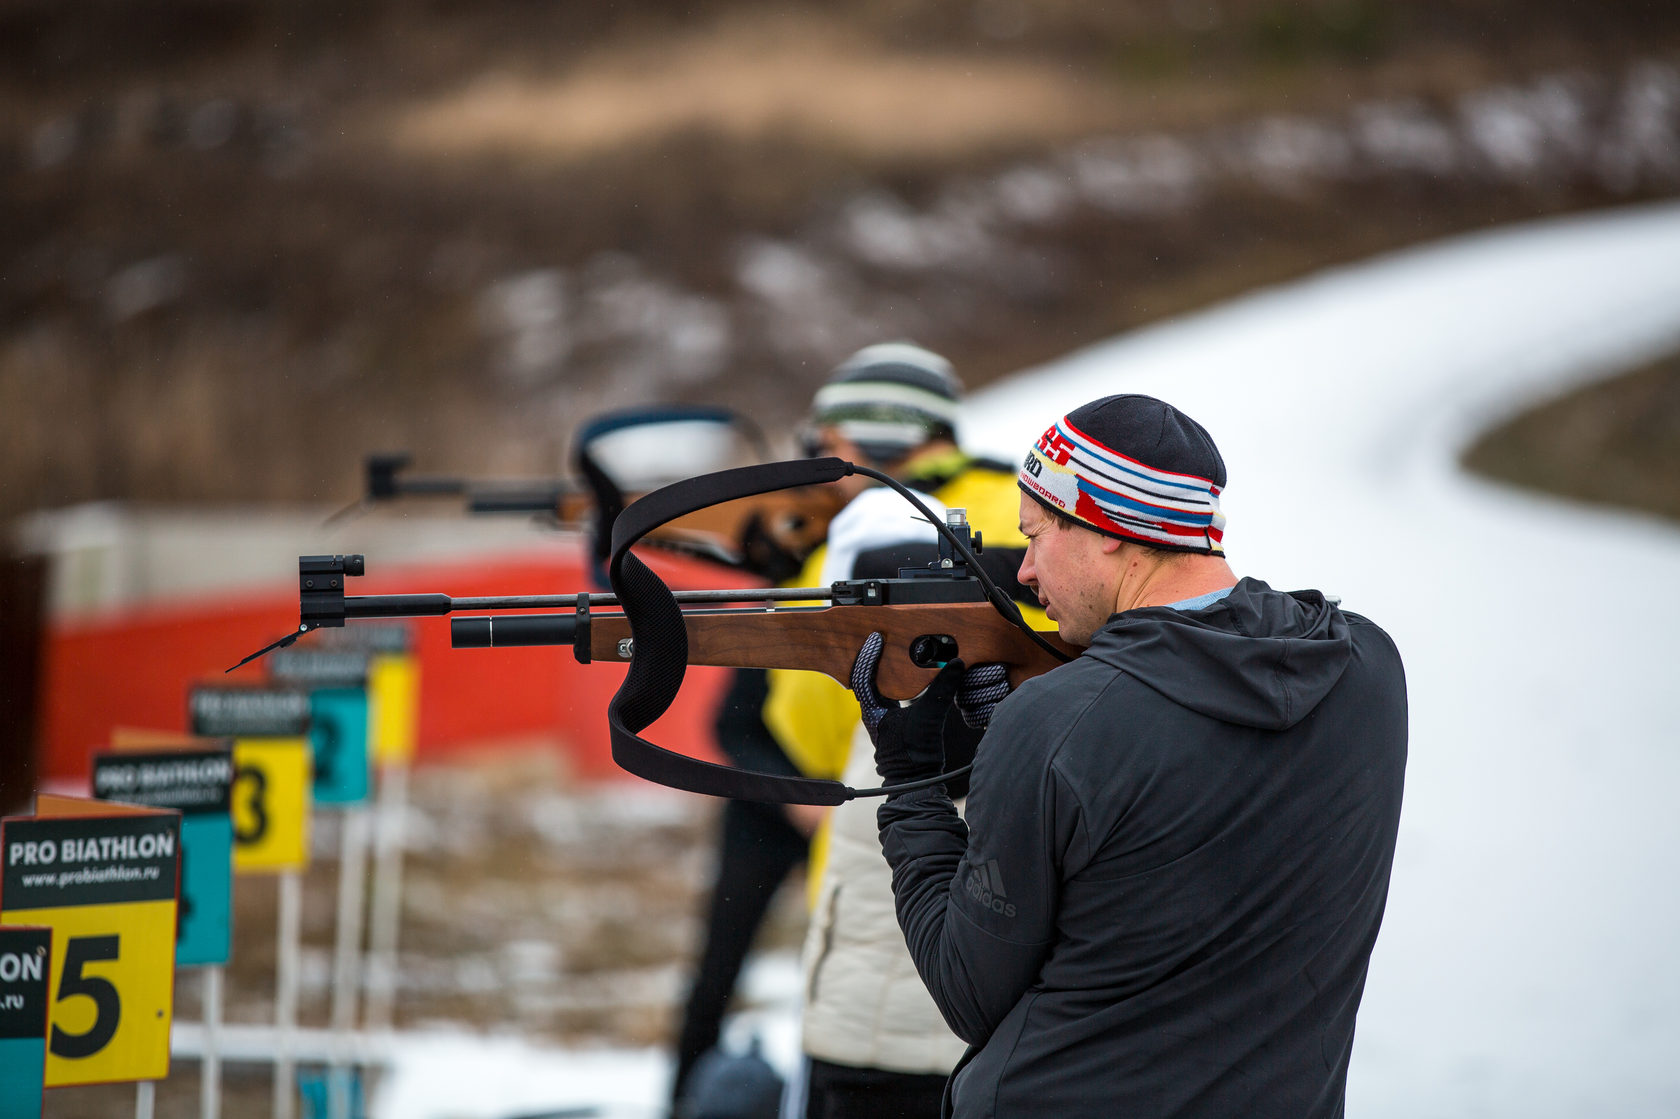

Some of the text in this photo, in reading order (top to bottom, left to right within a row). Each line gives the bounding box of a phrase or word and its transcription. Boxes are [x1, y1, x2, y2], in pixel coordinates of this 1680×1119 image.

[9, 833, 175, 866] PRO BIATHLON
[22, 865, 160, 888] www.probiathlon.ru
[966, 876, 1017, 918] adidas
[0, 952, 43, 982] ON
[50, 933, 121, 1060] 5
